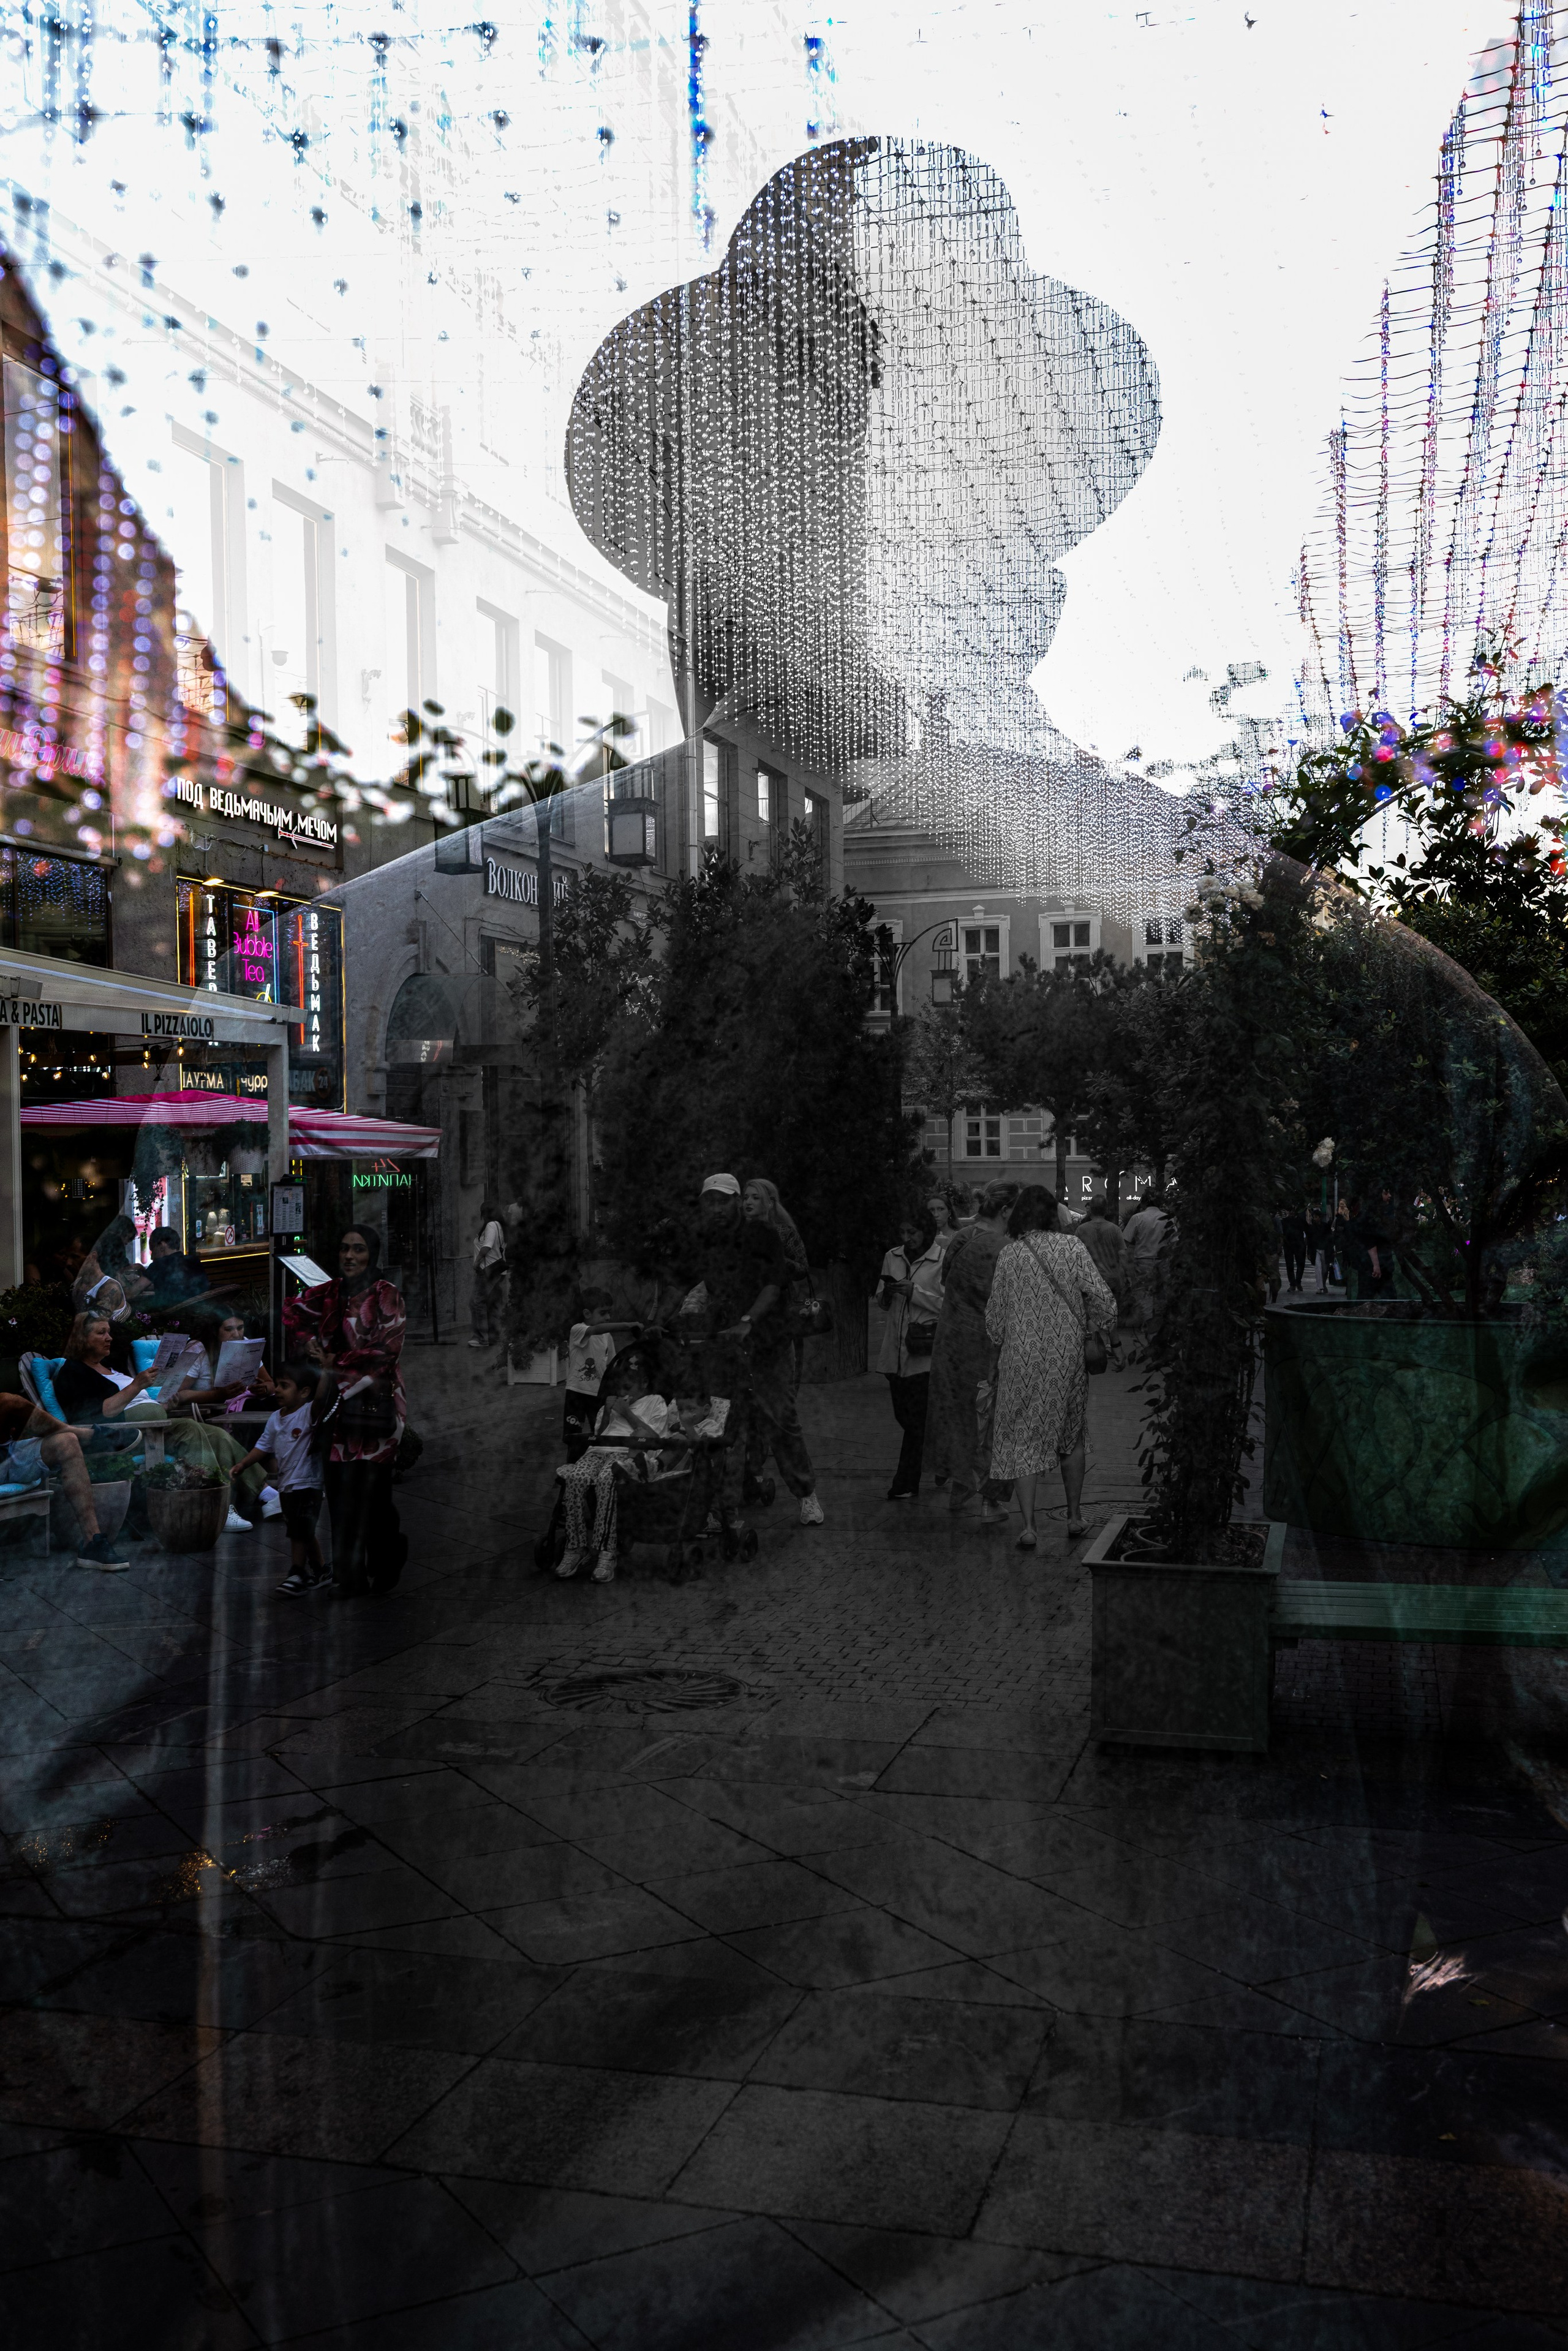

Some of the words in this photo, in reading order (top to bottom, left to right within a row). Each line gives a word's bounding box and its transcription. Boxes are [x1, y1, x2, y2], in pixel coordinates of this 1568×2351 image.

[177, 777, 204, 810] ПОД
[209, 787, 293, 831] ВЕДЬМАЧЬИМ
[297, 813, 337, 843] МЕЧОМ
[245, 910, 260, 932] All
[233, 931, 273, 959] Bubble
[241, 958, 265, 983] Tea
[310, 912, 320, 1052] ВЕДЬМАК
[11, 1001, 20, 1024] &
[23, 1002, 59, 1027] PASTA
[141, 1012, 152, 1034] IL
[154, 1013, 213, 1038] PIZZAIOLO
[318, 1075, 328, 1089] 24
